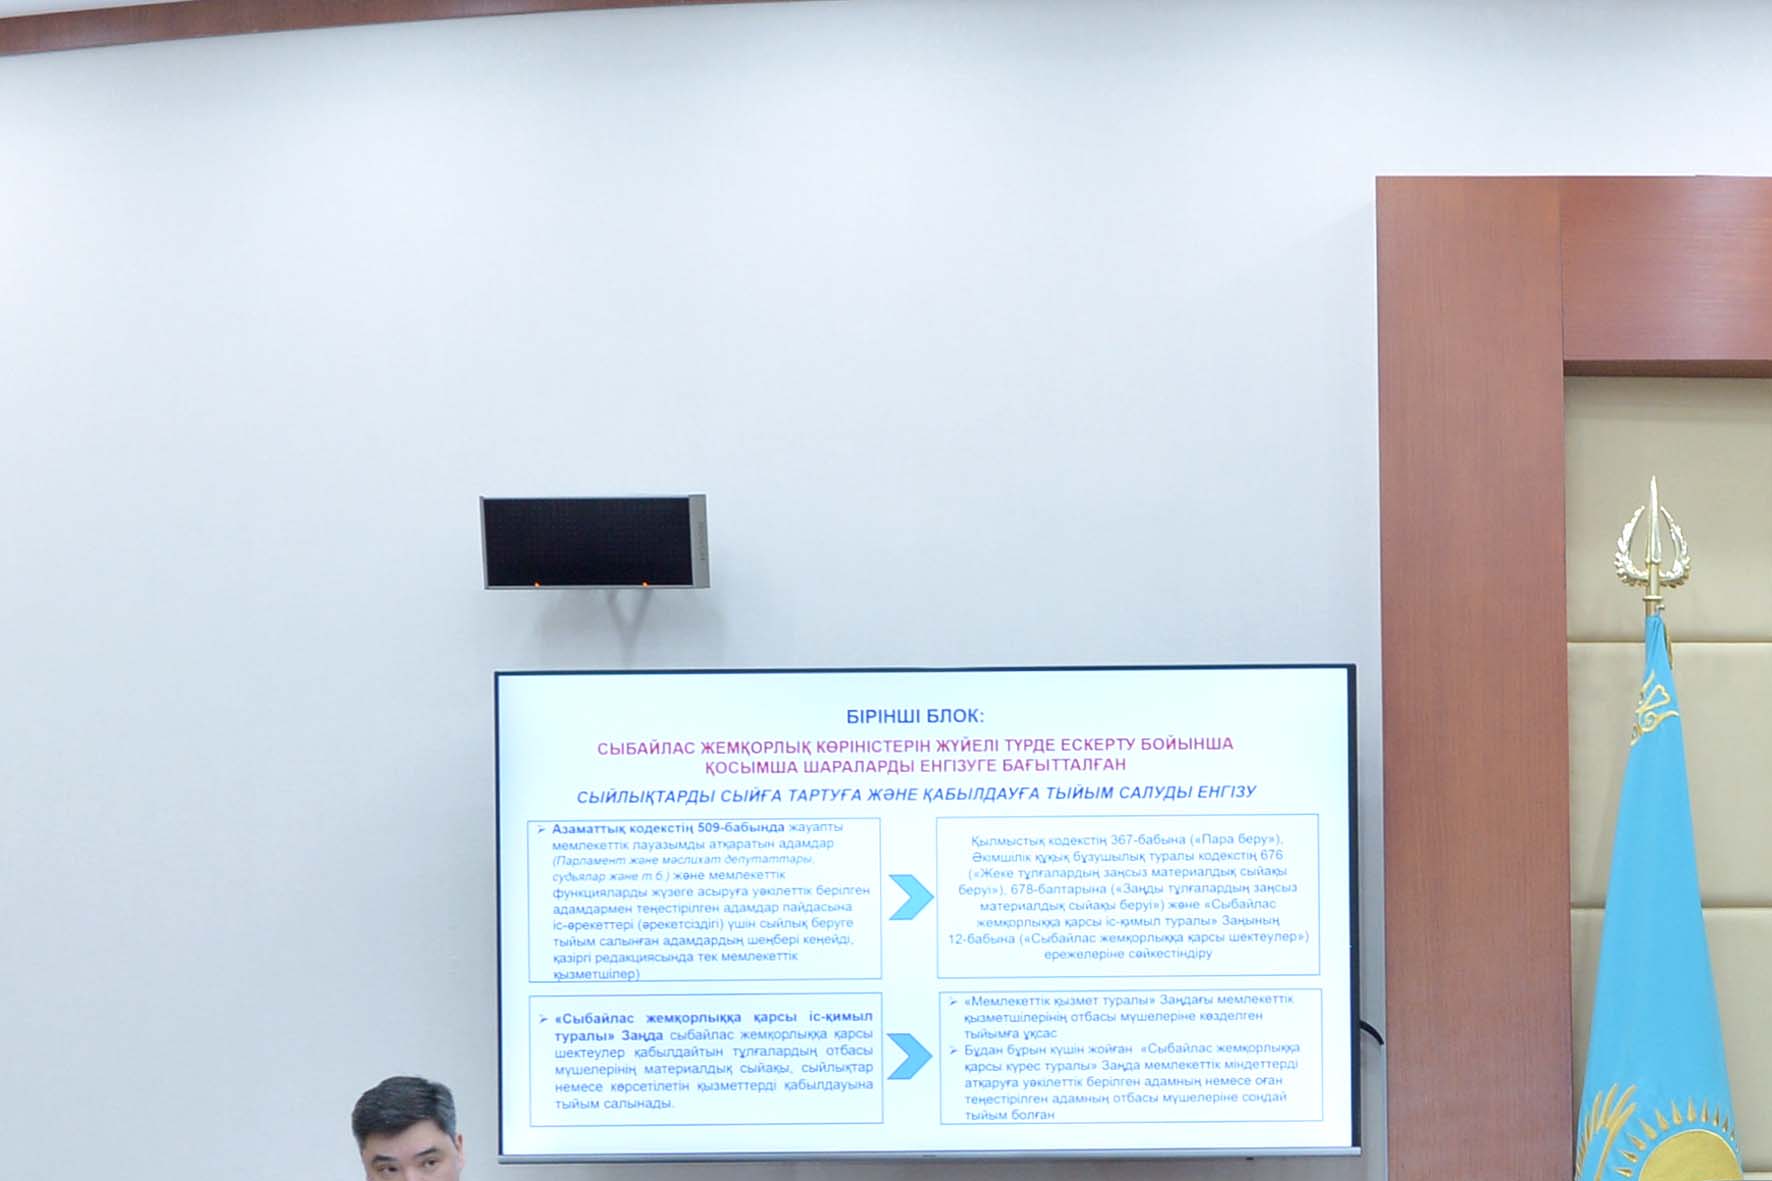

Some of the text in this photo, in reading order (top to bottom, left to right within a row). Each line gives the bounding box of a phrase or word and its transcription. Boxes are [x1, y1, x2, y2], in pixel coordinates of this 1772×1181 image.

[846, 708, 984, 724] БІРІНШІ БЛОК:
[597, 737, 1234, 756] СЫБАЙЛАС ЖЕМҚОРЛЫҚ КӨРІНІСТЕРІН ЖҮЙЕЛІ ТҮРДЕ ЕСКЕРТУ БОЙЫНША
[705, 757, 1125, 776] ҚОСЫМША ШАРАЛАРДЫ ЕНГІЗУГЕ БАҒЫТТАЛҒАН
[576, 785, 1256, 806] СЫЙЛЫҚТАРДЫ СЫЙҒА ТАРТУҒА ЖӘНЕ ҚАБЫЛДАУҒА ТЫЙЫМ САЛУДЫ ЕНГІЗУ
[551, 821, 843, 834] Азаматтық кодекстің 509-бабында жауапты
[646, 1014, 741, 1024] жемқорлыққа
[753, 1013, 797, 1023] қарсы
[809, 1012, 873, 1022] іс-қимыл
